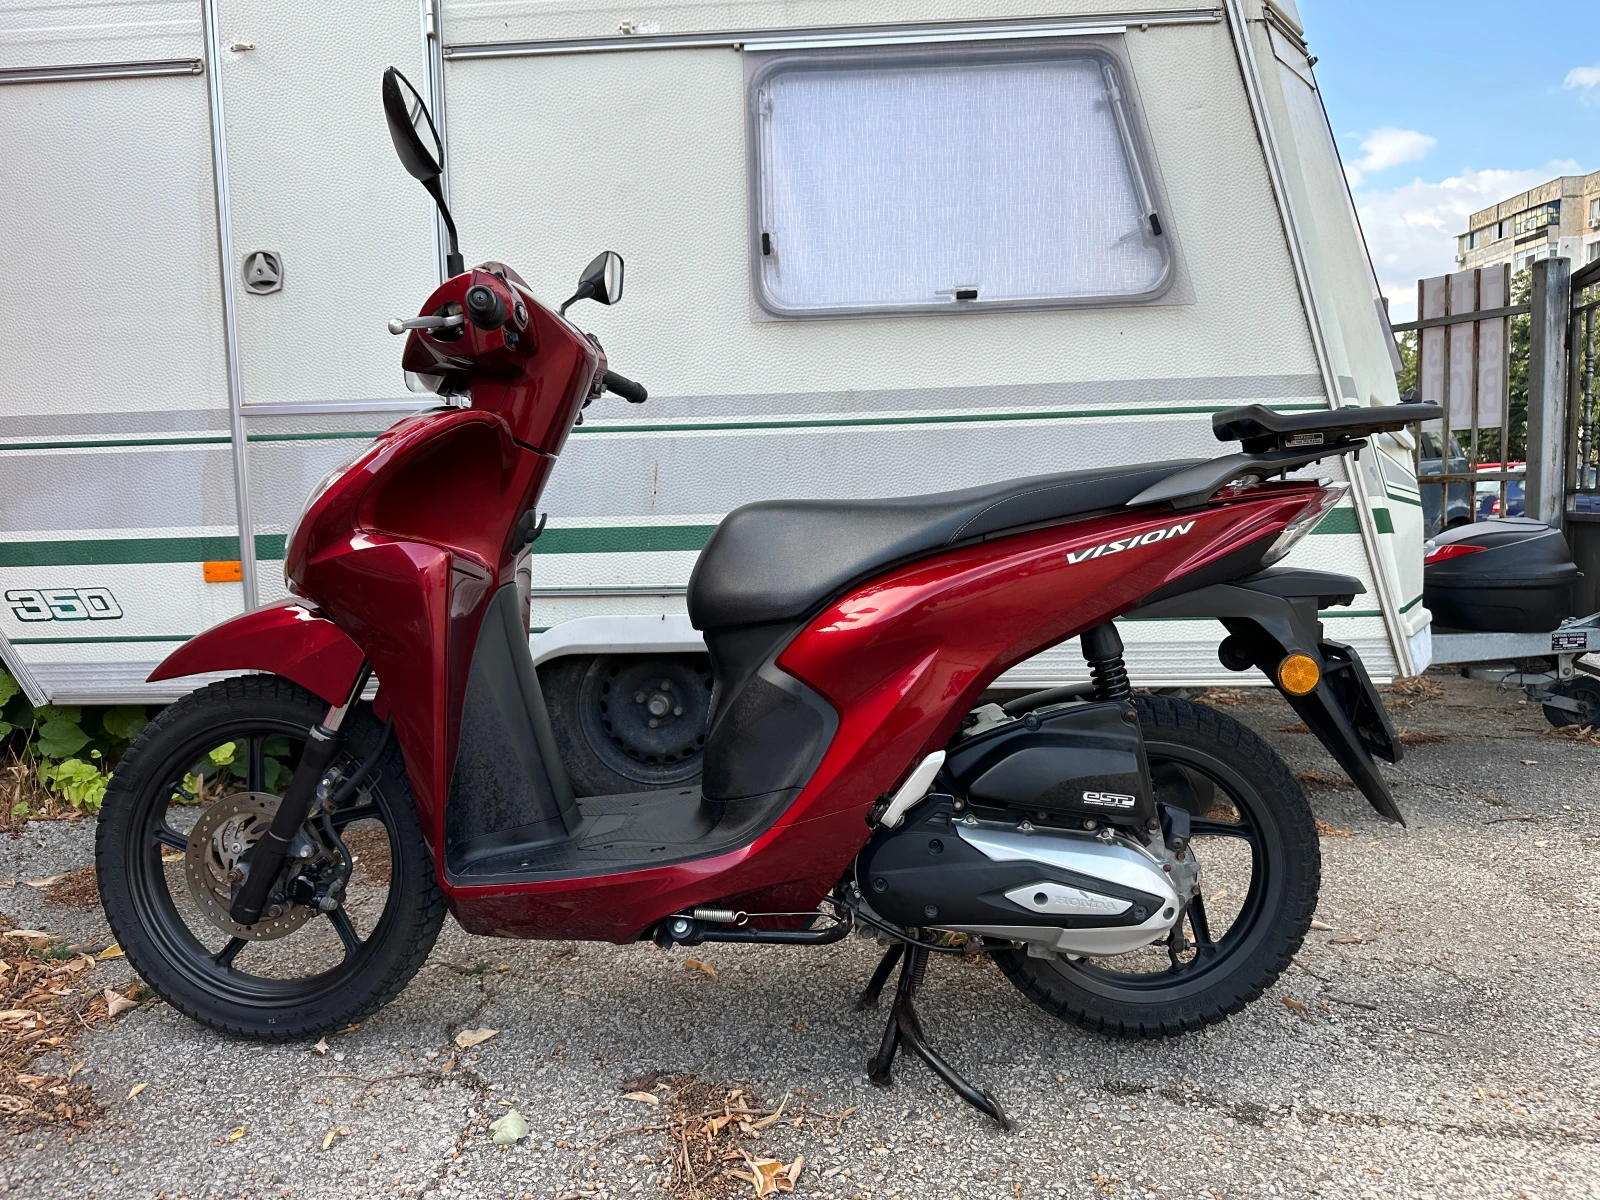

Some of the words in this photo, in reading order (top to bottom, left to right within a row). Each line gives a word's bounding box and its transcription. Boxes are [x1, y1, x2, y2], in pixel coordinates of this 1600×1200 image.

[1066, 520, 1196, 565] VISION
[4, 586, 124, 622] 350
[1055, 895, 1118, 910] HONDA
